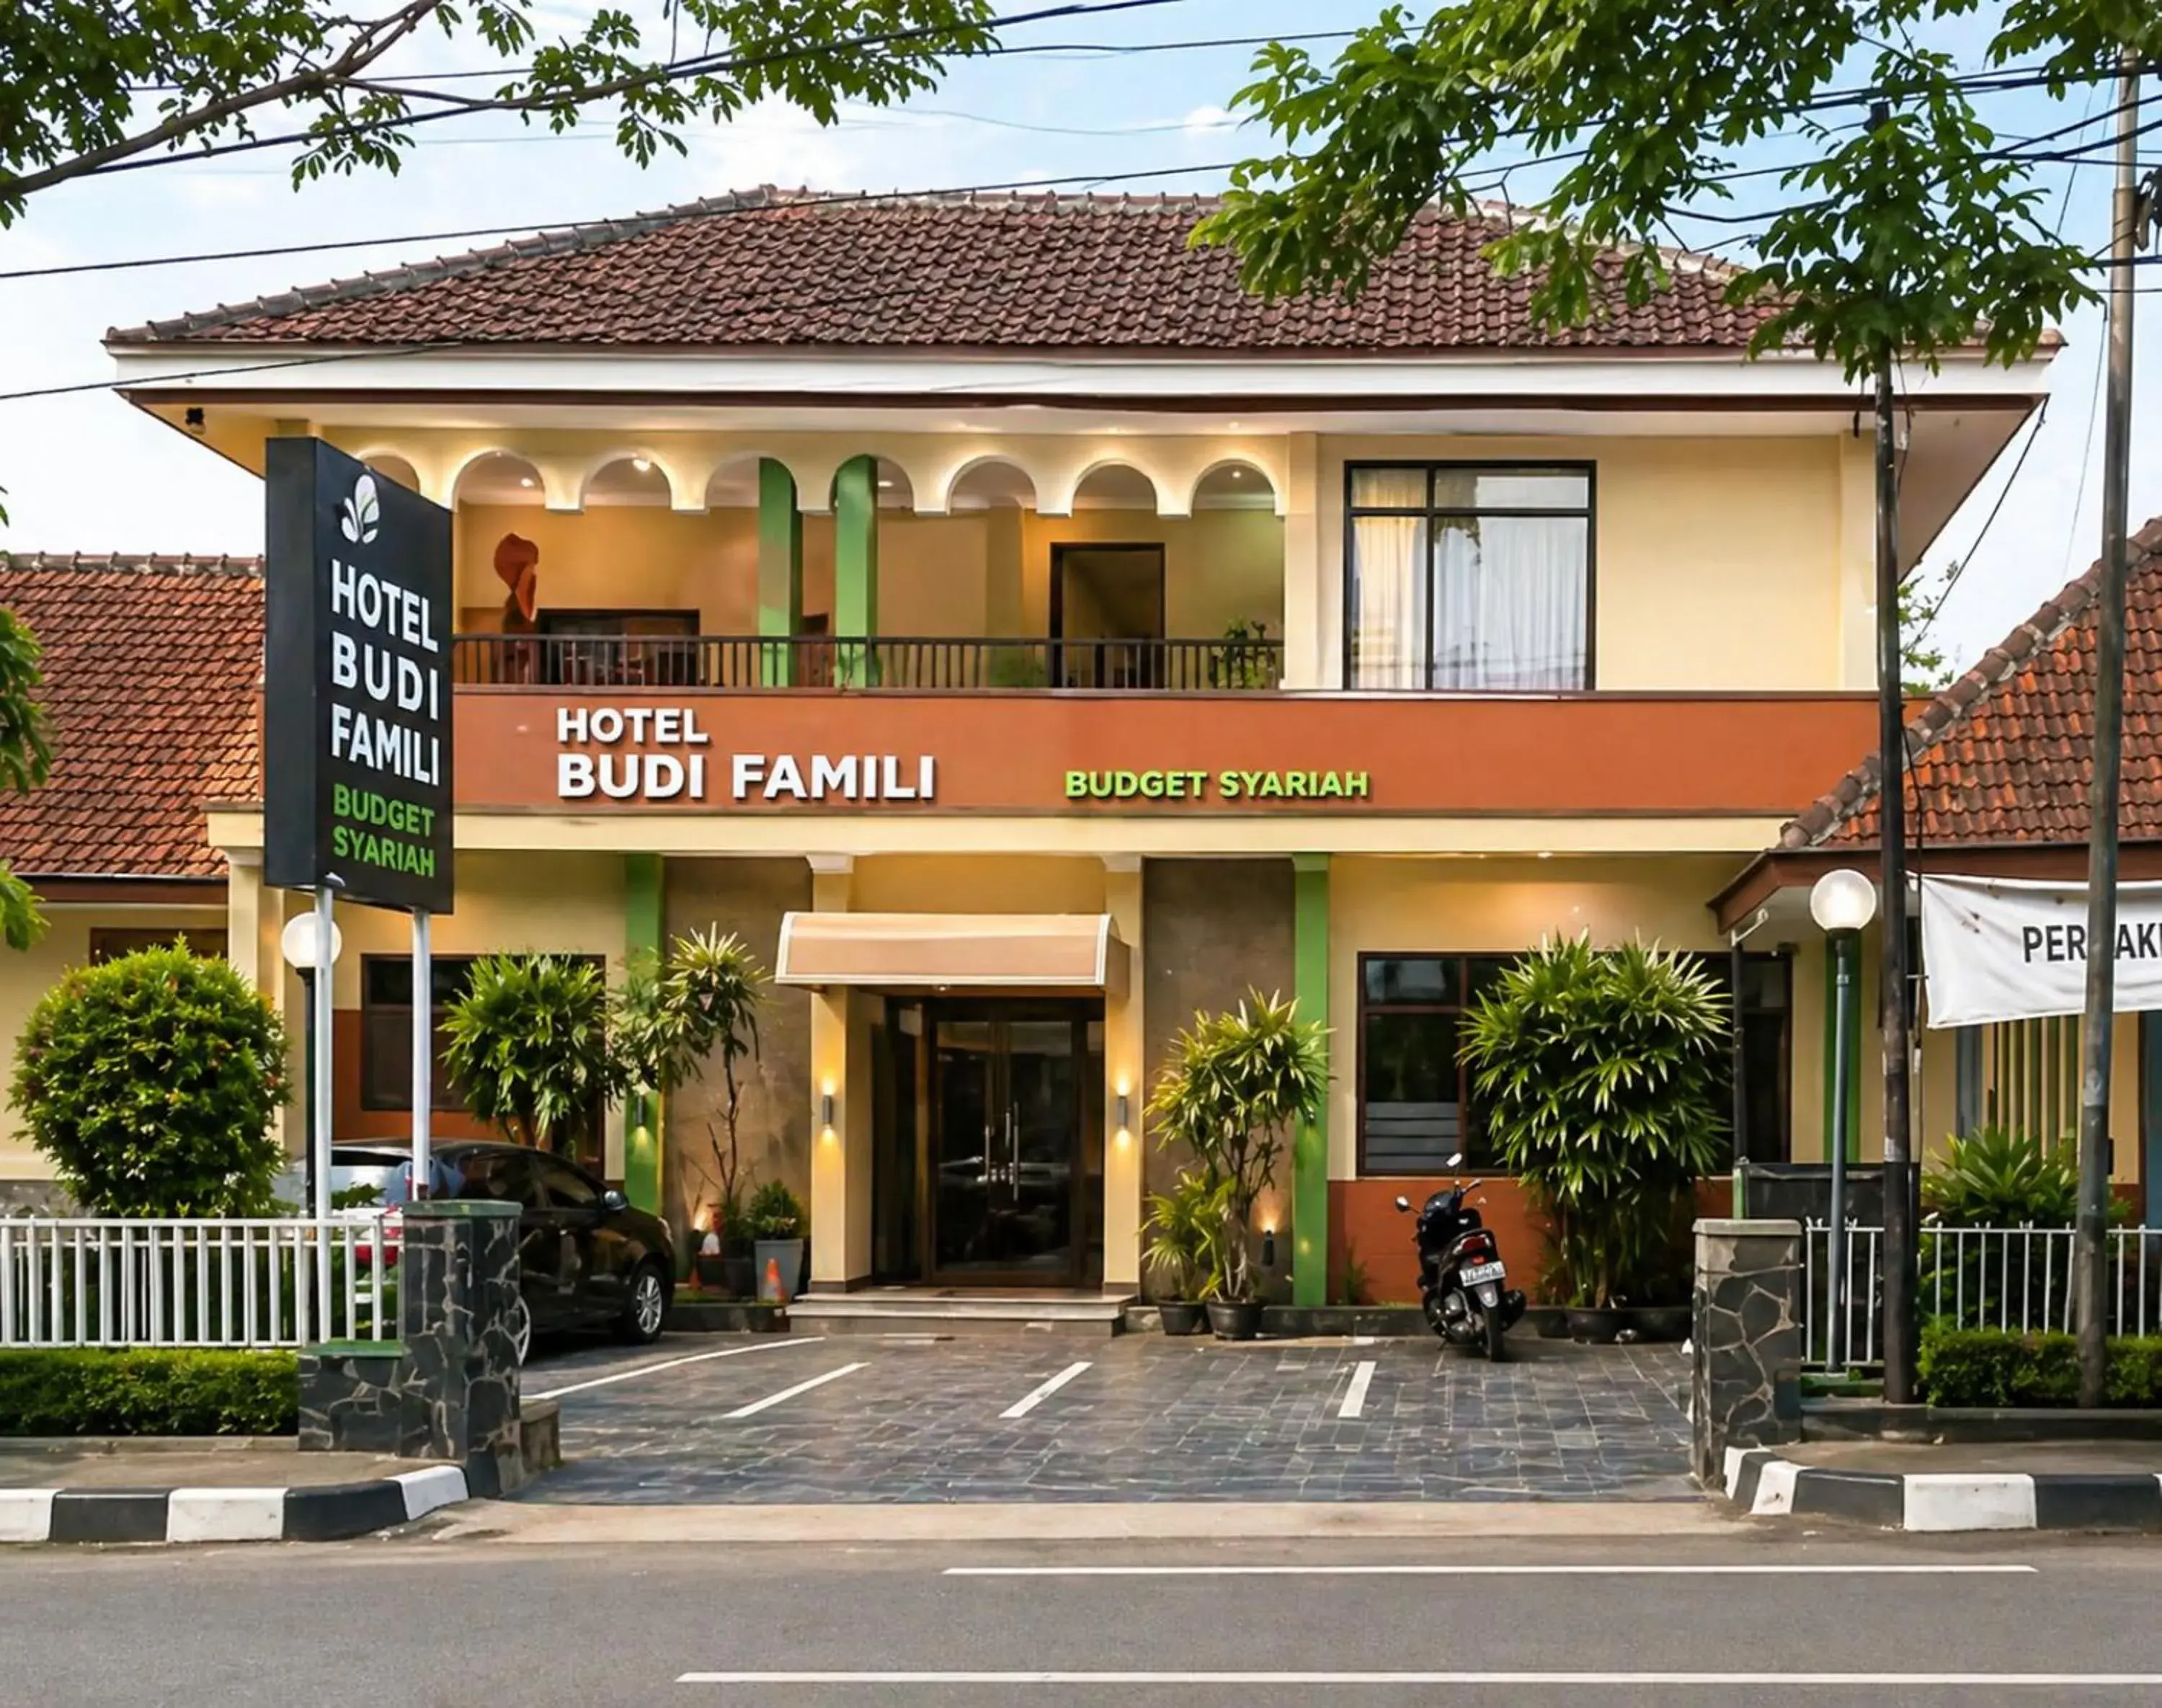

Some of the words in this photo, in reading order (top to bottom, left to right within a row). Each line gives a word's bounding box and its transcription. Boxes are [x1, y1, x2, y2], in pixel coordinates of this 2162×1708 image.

[332, 559, 438, 653] HOTEL
[332, 631, 438, 721] BUDI
[332, 702, 439, 786] FAMILI
[556, 707, 708, 743] HOTEL
[557, 752, 703, 798] BUDI
[731, 754, 934, 799] FAMILI
[1065, 772, 1205, 797] BUDGET
[1221, 773, 1368, 797] SYARIAH
[333, 783, 435, 837] BUDGET
[332, 824, 435, 877] SYARIAH
